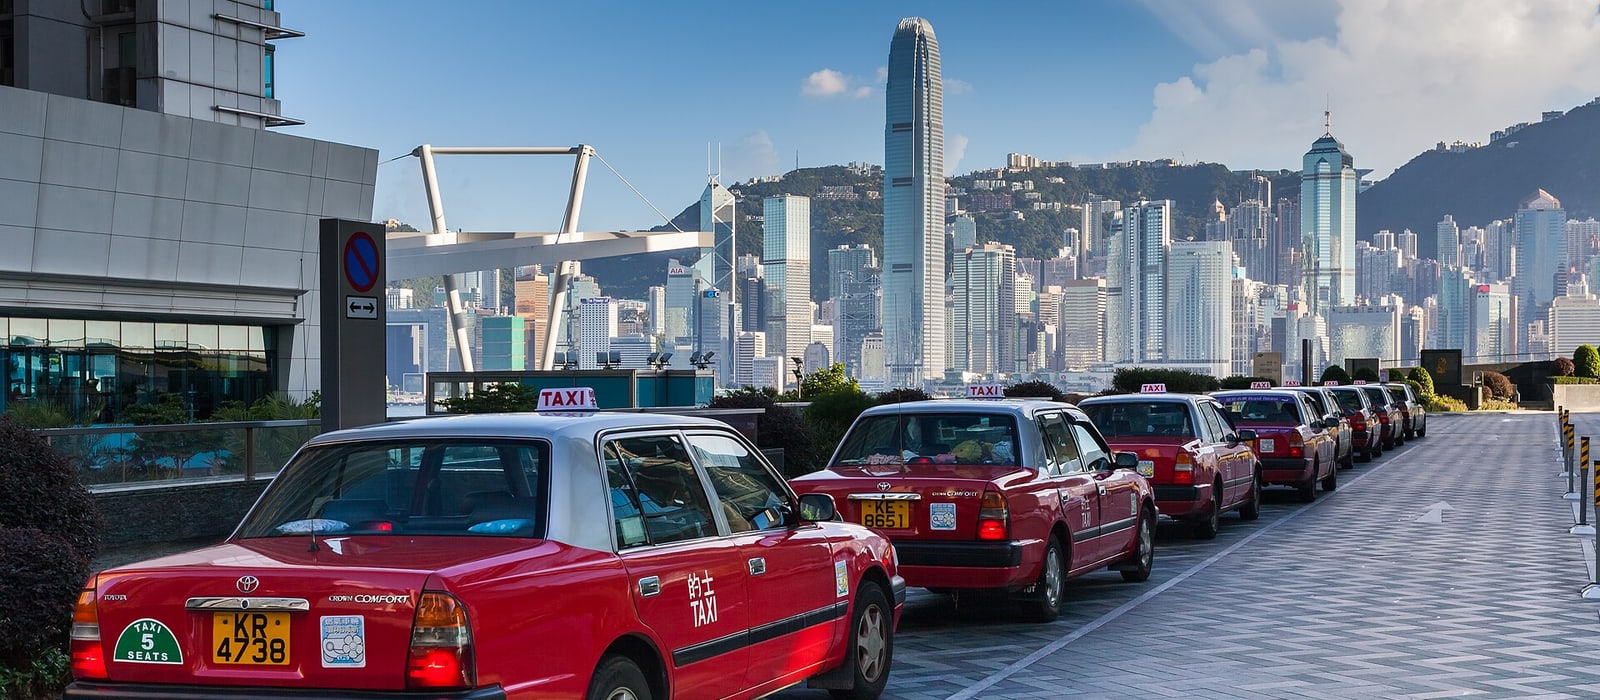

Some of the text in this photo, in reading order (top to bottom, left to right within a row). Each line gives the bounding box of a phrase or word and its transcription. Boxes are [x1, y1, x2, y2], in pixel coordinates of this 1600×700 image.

[970, 386, 998, 396] TAXI
[1143, 384, 1164, 392] TAXI
[541, 390, 585, 407] TAXI
[875, 501, 895, 514] KE
[864, 514, 903, 528] 8651
[688, 570, 714, 600] 的士
[354, 594, 410, 603] COMFORT
[690, 595, 718, 628] TAXI
[133, 621, 162, 634] TAXI
[234, 613, 268, 639] KR
[140, 633, 155, 650] 5
[127, 650, 168, 661] SEATS
[216, 637, 286, 663] 4738
